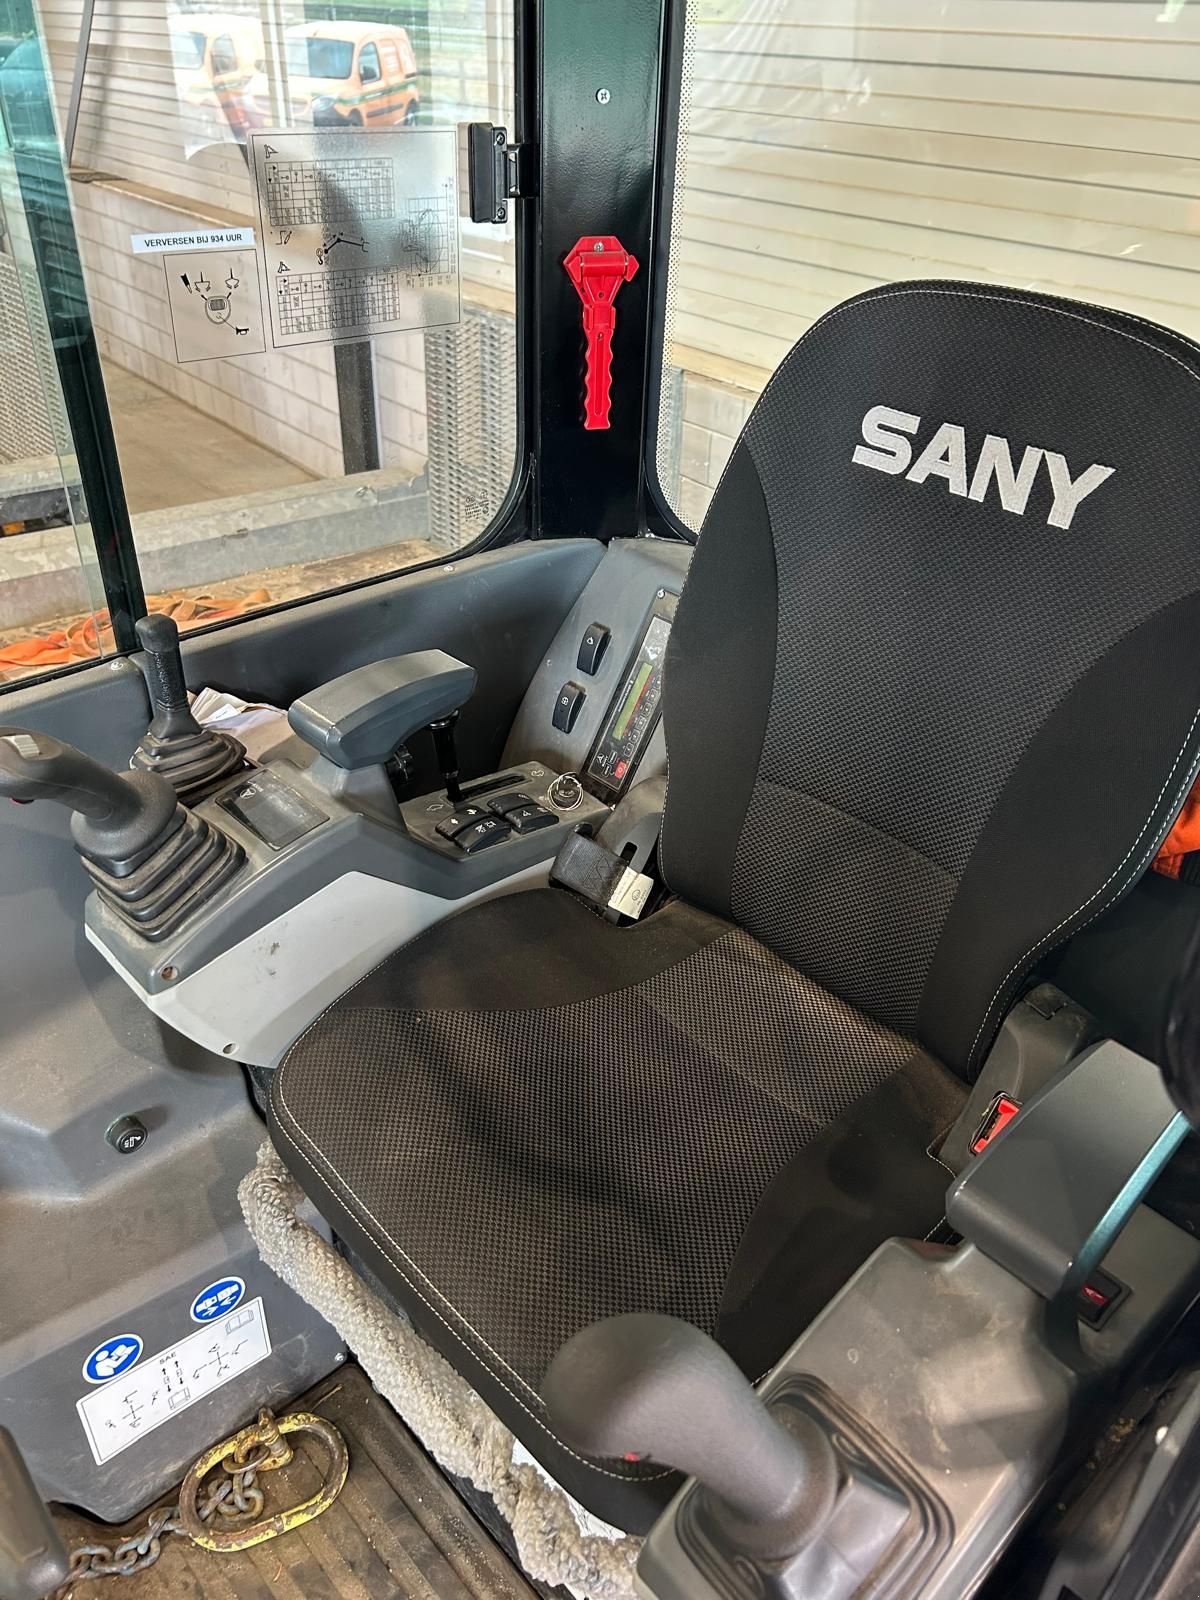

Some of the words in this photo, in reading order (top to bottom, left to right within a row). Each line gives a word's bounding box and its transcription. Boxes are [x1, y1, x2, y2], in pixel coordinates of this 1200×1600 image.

[144, 236, 195, 247] VERVERSEN
[196, 235, 209, 244] BIJ
[210, 234, 224, 242] 934
[225, 233, 243, 242] UUR
[852, 405, 1117, 530] SANY
